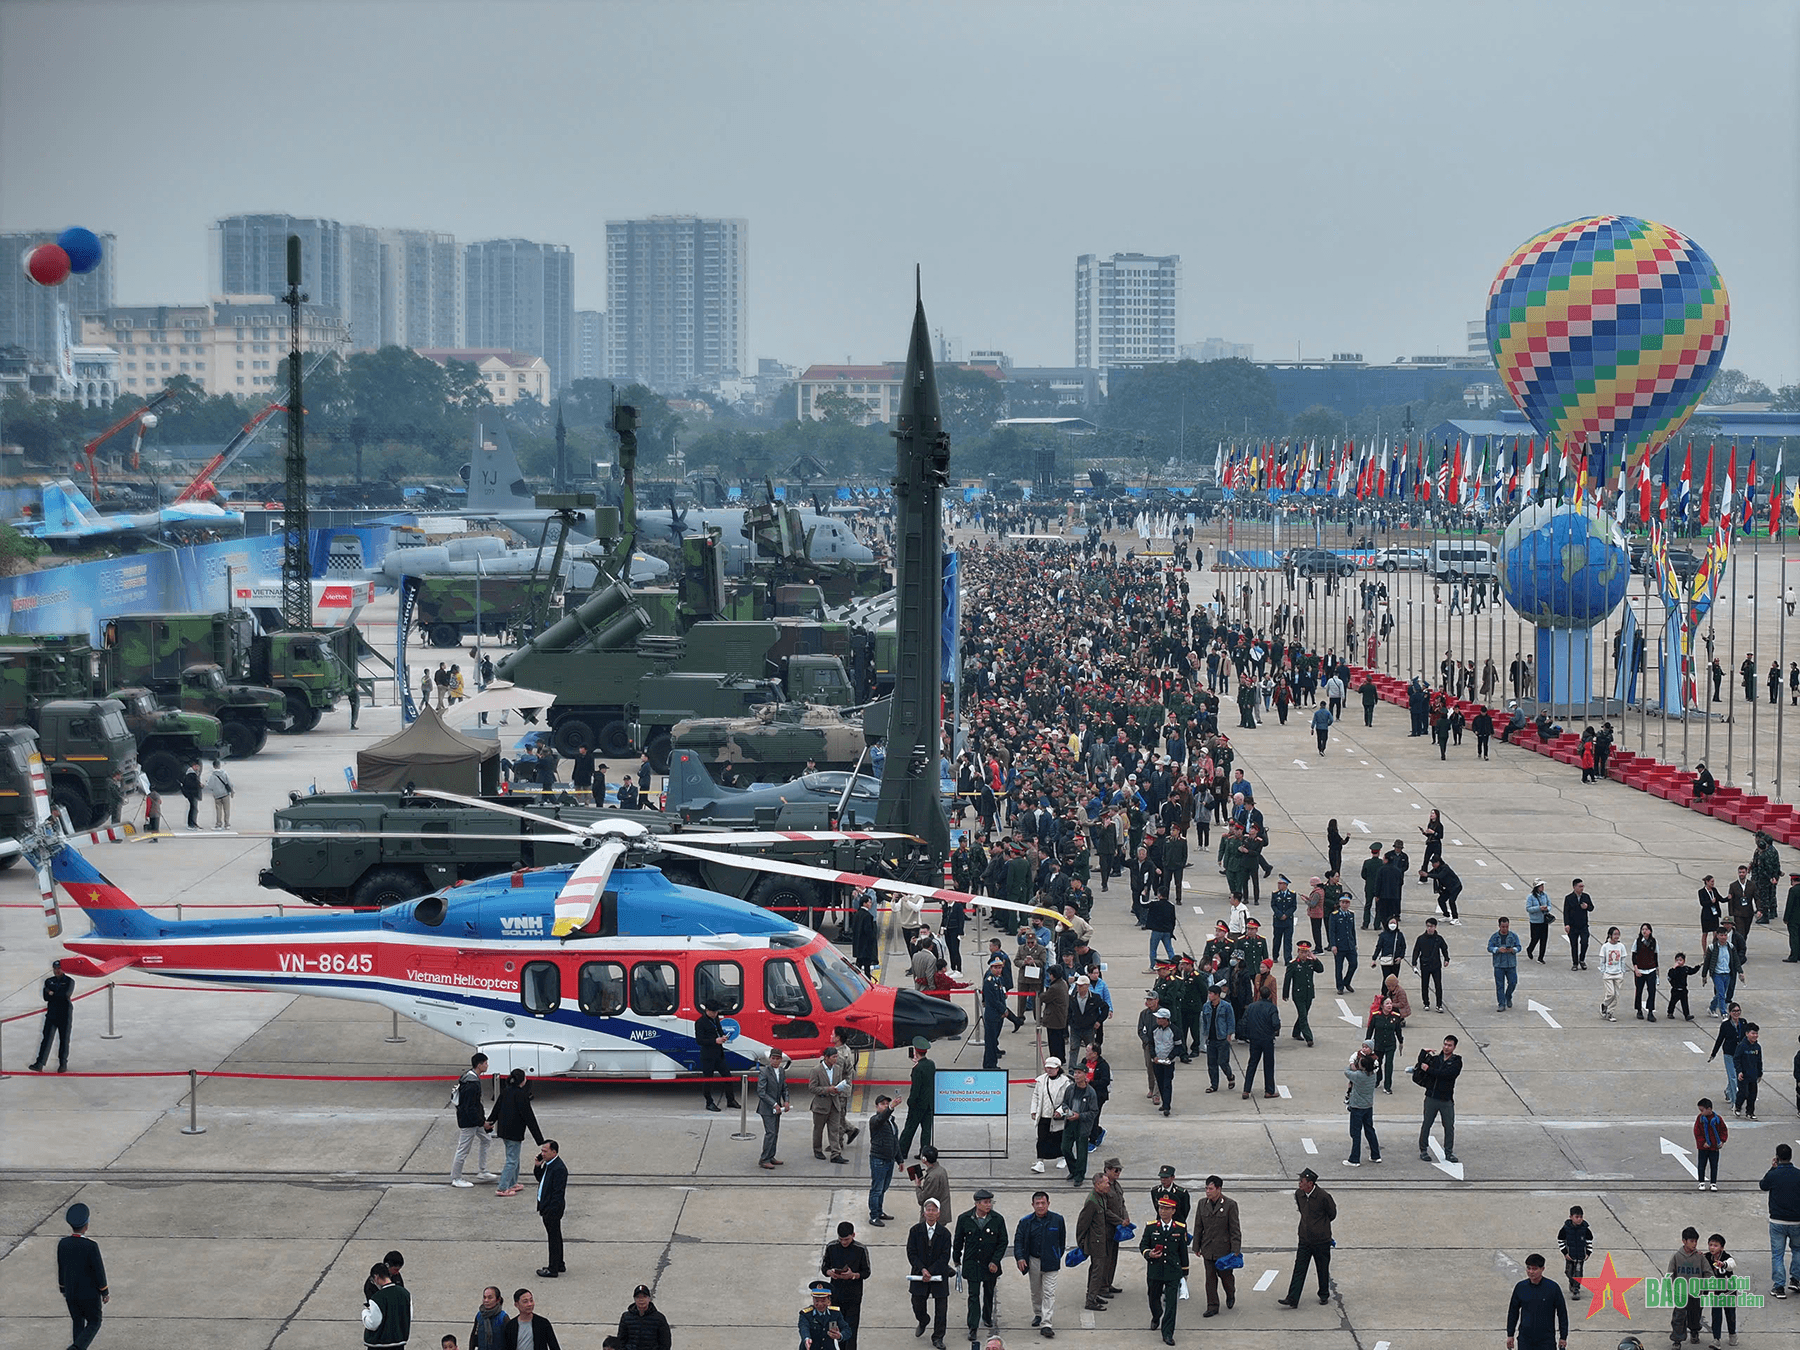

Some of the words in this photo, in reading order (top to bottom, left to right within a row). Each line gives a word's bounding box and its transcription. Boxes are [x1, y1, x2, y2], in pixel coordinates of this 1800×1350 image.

[482, 471, 497, 485] YJ
[500, 916, 543, 929] VNH
[279, 954, 373, 972] VN-8645
[406, 968, 452, 985] Vietnam
[453, 974, 519, 990] Helicopters
